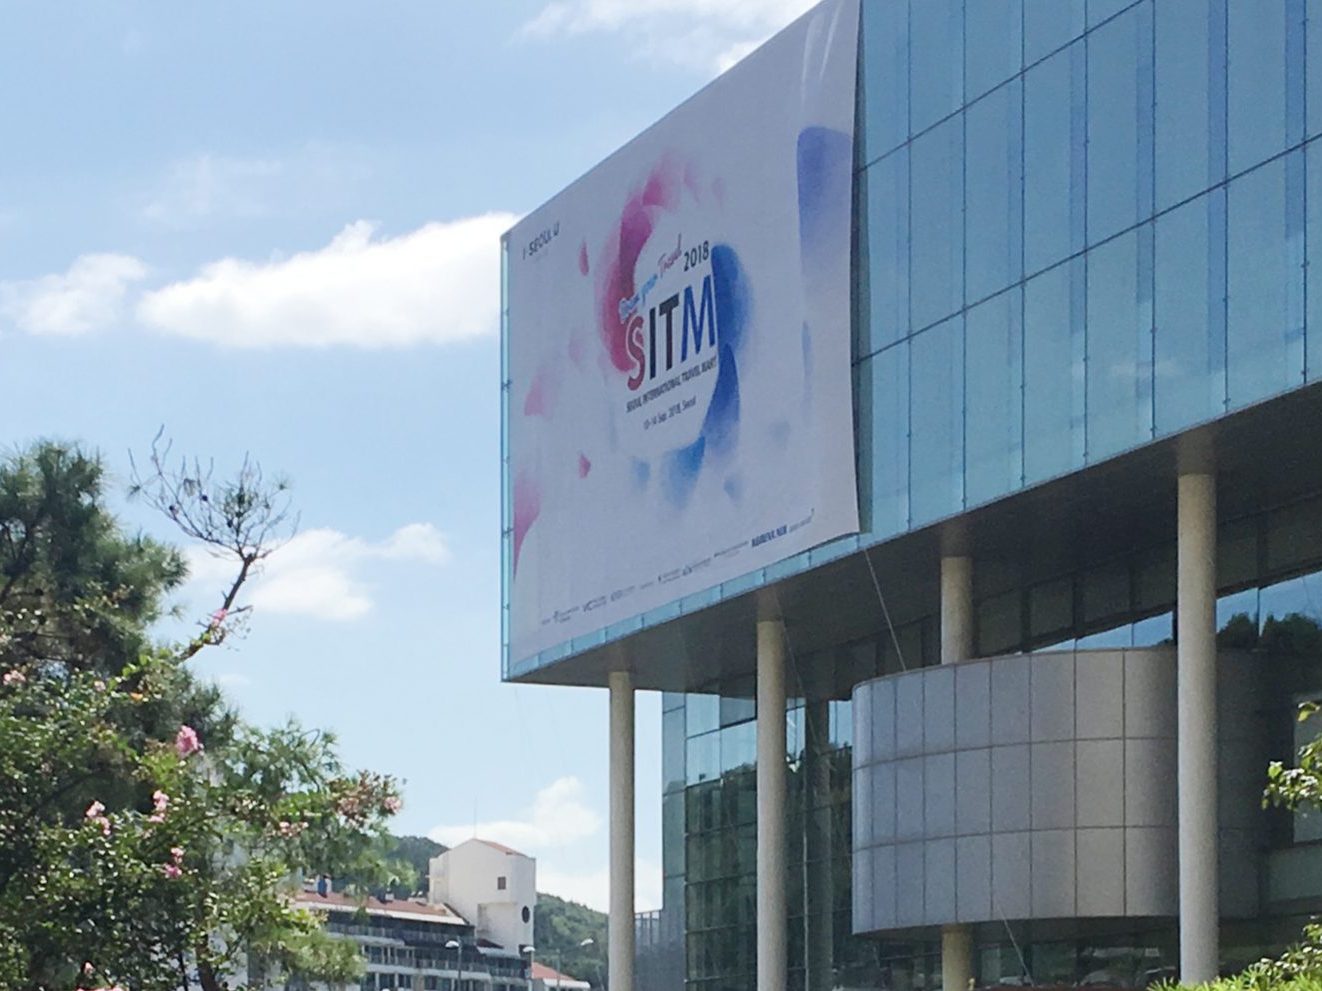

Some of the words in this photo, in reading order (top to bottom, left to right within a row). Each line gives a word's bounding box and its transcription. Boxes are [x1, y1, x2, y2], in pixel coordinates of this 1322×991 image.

[683, 240, 710, 272] 2018
[625, 274, 716, 391] SITM
[643, 376, 681, 404] INTERNATIONAL
[681, 365, 701, 382] TRAVEL
